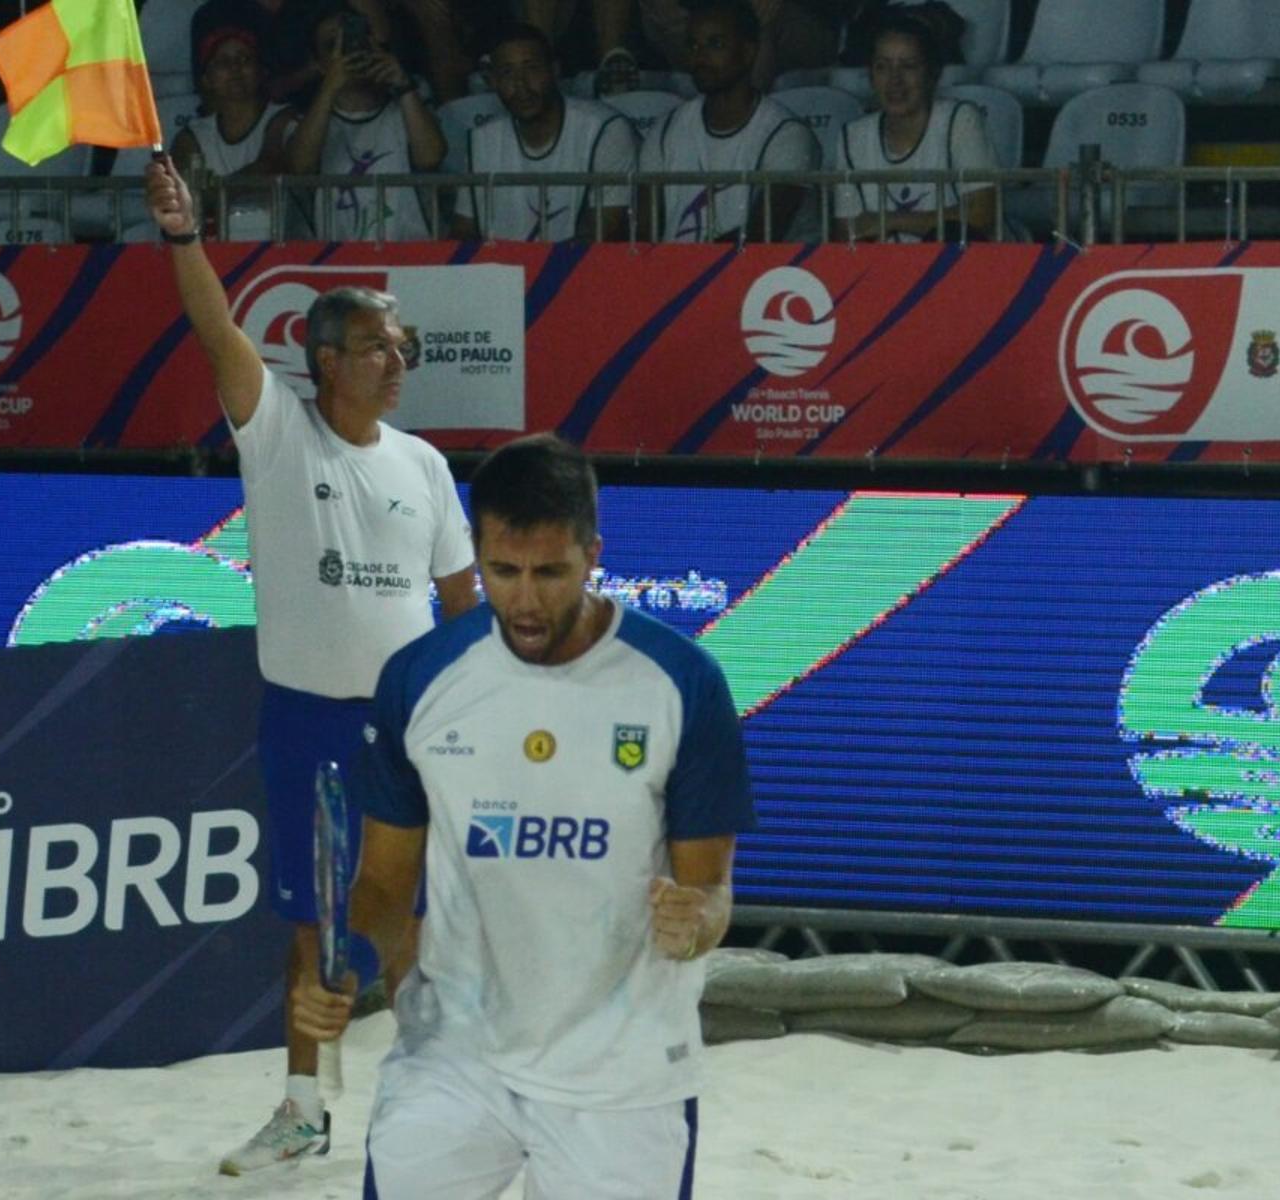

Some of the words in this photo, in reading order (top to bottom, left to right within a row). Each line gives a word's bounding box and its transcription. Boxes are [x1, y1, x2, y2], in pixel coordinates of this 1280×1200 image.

[1107, 111, 1149, 127] 0535
[424, 331, 471, 344] CIDADE
[474, 331, 492, 344] DE
[424, 345, 458, 362] SÃO
[460, 347, 513, 363] PAULO
[460, 364, 487, 375] HOST
[488, 364, 512, 375] CITY
[731, 403, 802, 423] WORLD
[805, 404, 846, 423] CUP
[345, 561, 383, 574] CIDADE
[386, 562, 401, 574] DE
[345, 571, 373, 588] SÃO
[375, 576, 412, 590] PAULO
[617, 730, 644, 742] CBT
[472, 798, 519, 811] banco
[515, 816, 611, 861] BRB
[22, 808, 261, 938] BRB
